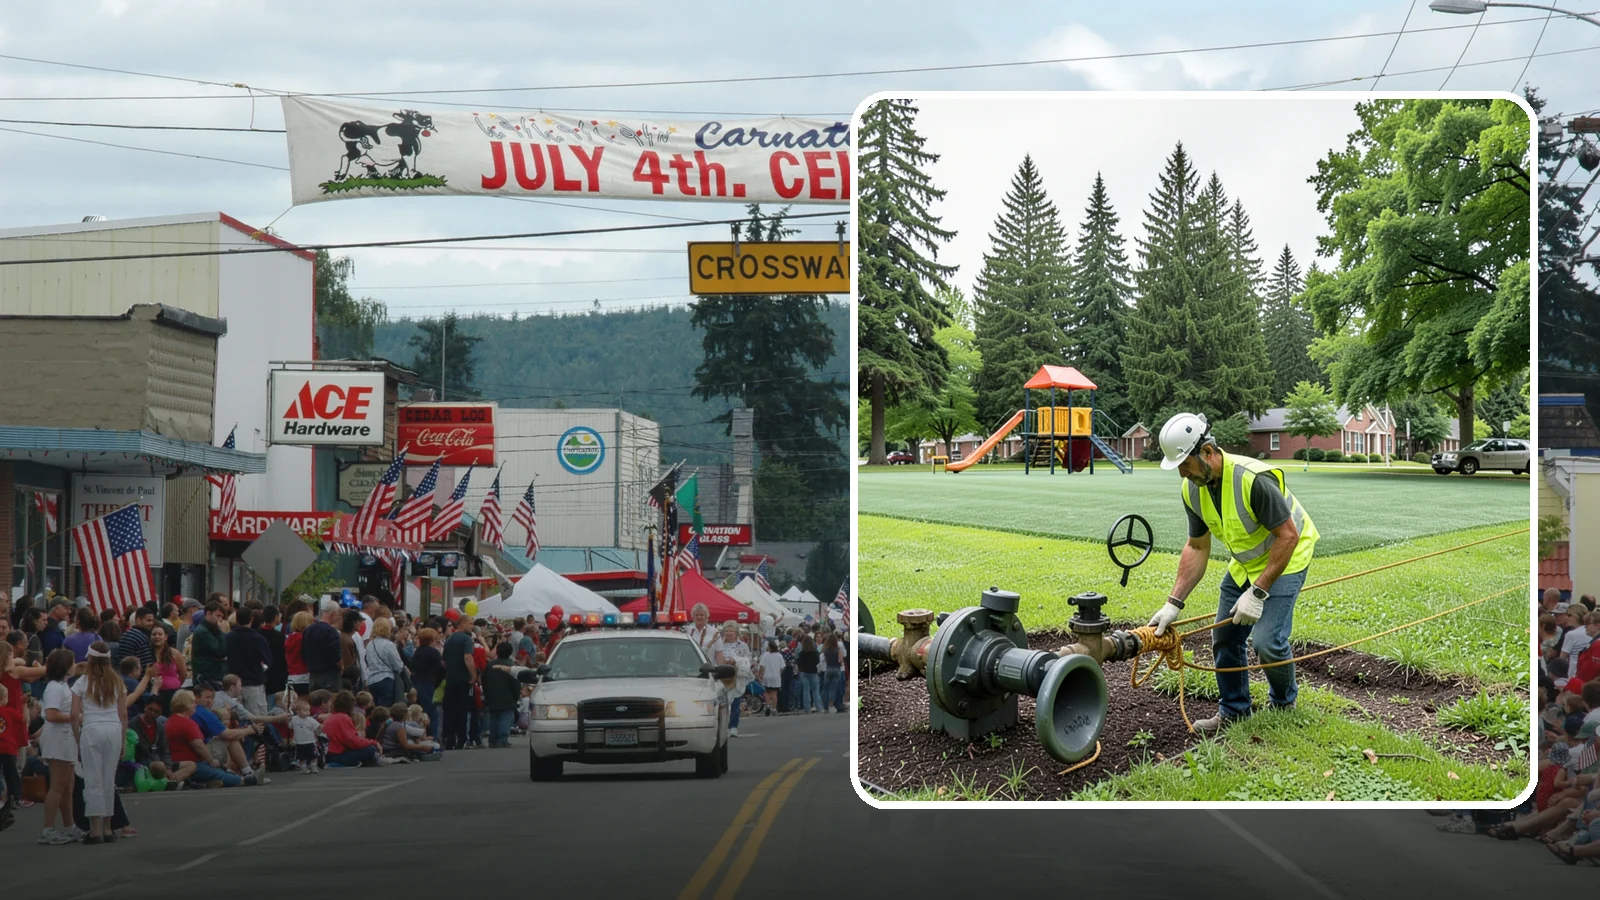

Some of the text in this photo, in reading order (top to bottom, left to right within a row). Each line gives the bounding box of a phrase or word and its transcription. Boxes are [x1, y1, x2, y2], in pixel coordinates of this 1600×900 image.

[695, 121, 850, 150] Carnat
[481, 140, 605, 192] JULY
[632, 150, 746, 198] 4th.
[697, 254, 850, 280] CROSSWA
[283, 380, 373, 420] ACE
[405, 409, 452, 422] CEDAR
[283, 421, 370, 436] Hardware
[96, 485, 124, 495] Vincent
[126, 486, 136, 495] de
[137, 486, 155, 495] Paul
[688, 526, 741, 535] CRNATION
[699, 535, 730, 543] GLASS
